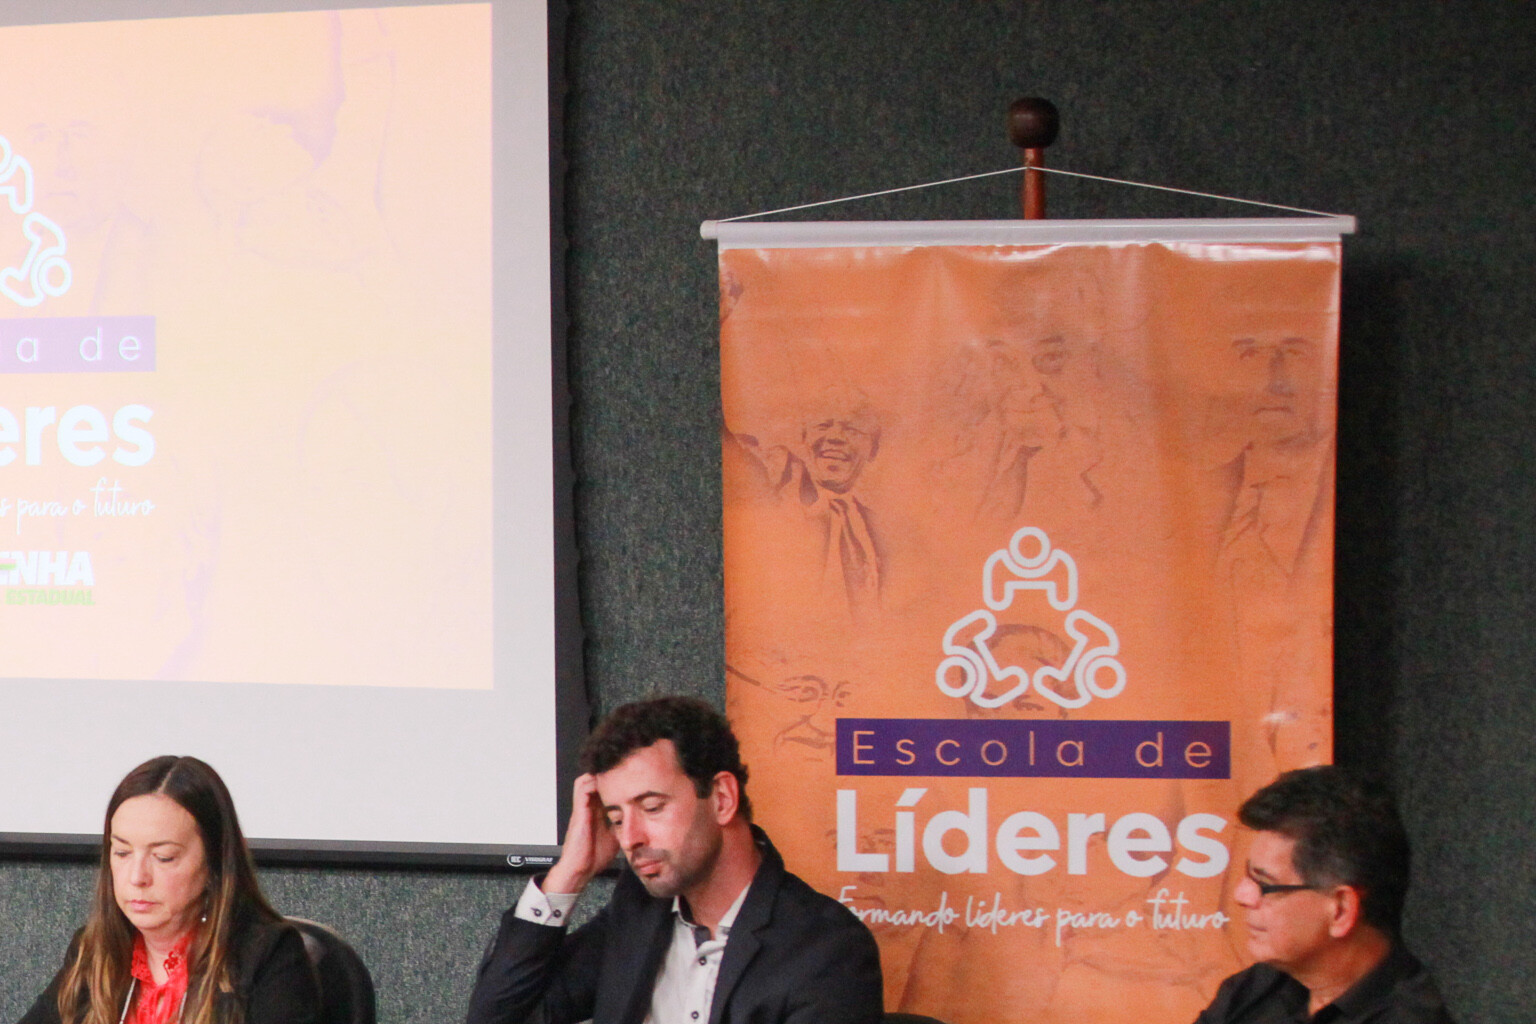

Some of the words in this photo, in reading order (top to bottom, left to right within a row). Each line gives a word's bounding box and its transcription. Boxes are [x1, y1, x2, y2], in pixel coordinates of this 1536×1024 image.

[79, 327, 142, 363] de
[16, 498, 68, 535] para
[71, 499, 88, 516] o
[89, 476, 157, 517] futuro
[5, 589, 96, 606] ESTADUAL
[852, 730, 1086, 767] Escola
[1135, 731, 1213, 769] de
[836, 787, 1231, 878] Líderes
[1055, 907, 1122, 948] para
[1125, 910, 1145, 928] o
[1146, 887, 1232, 930] futuro
